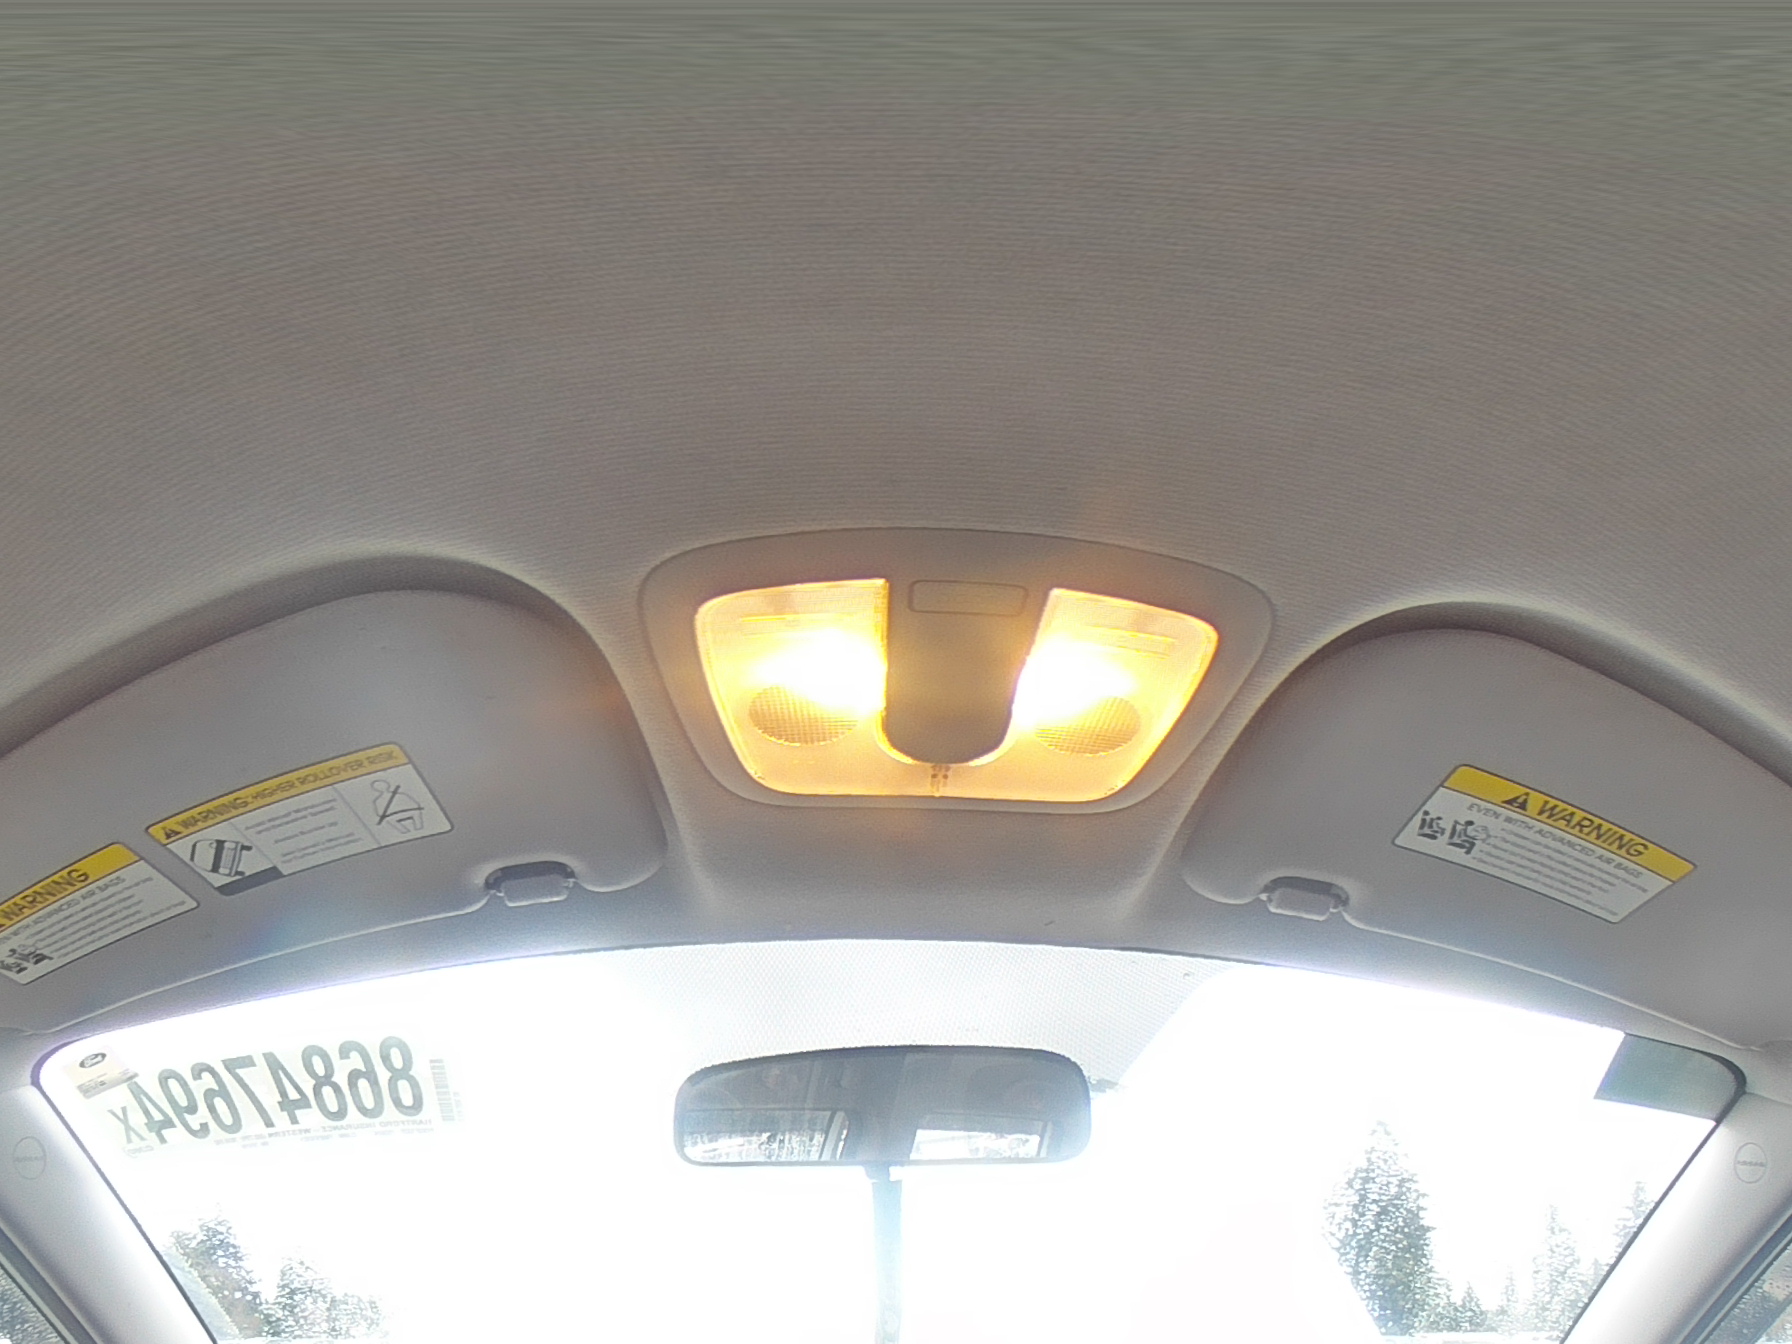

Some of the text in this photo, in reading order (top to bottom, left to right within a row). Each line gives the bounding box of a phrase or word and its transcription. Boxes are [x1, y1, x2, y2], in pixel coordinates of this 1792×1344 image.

[296, 759, 366, 786] ROLLOVER
[366, 750, 398, 766] RISK
[1466, 802, 1644, 879] EVEN WITH ADVANCED AIR BAGS
[1535, 800, 1650, 857] WARNING
